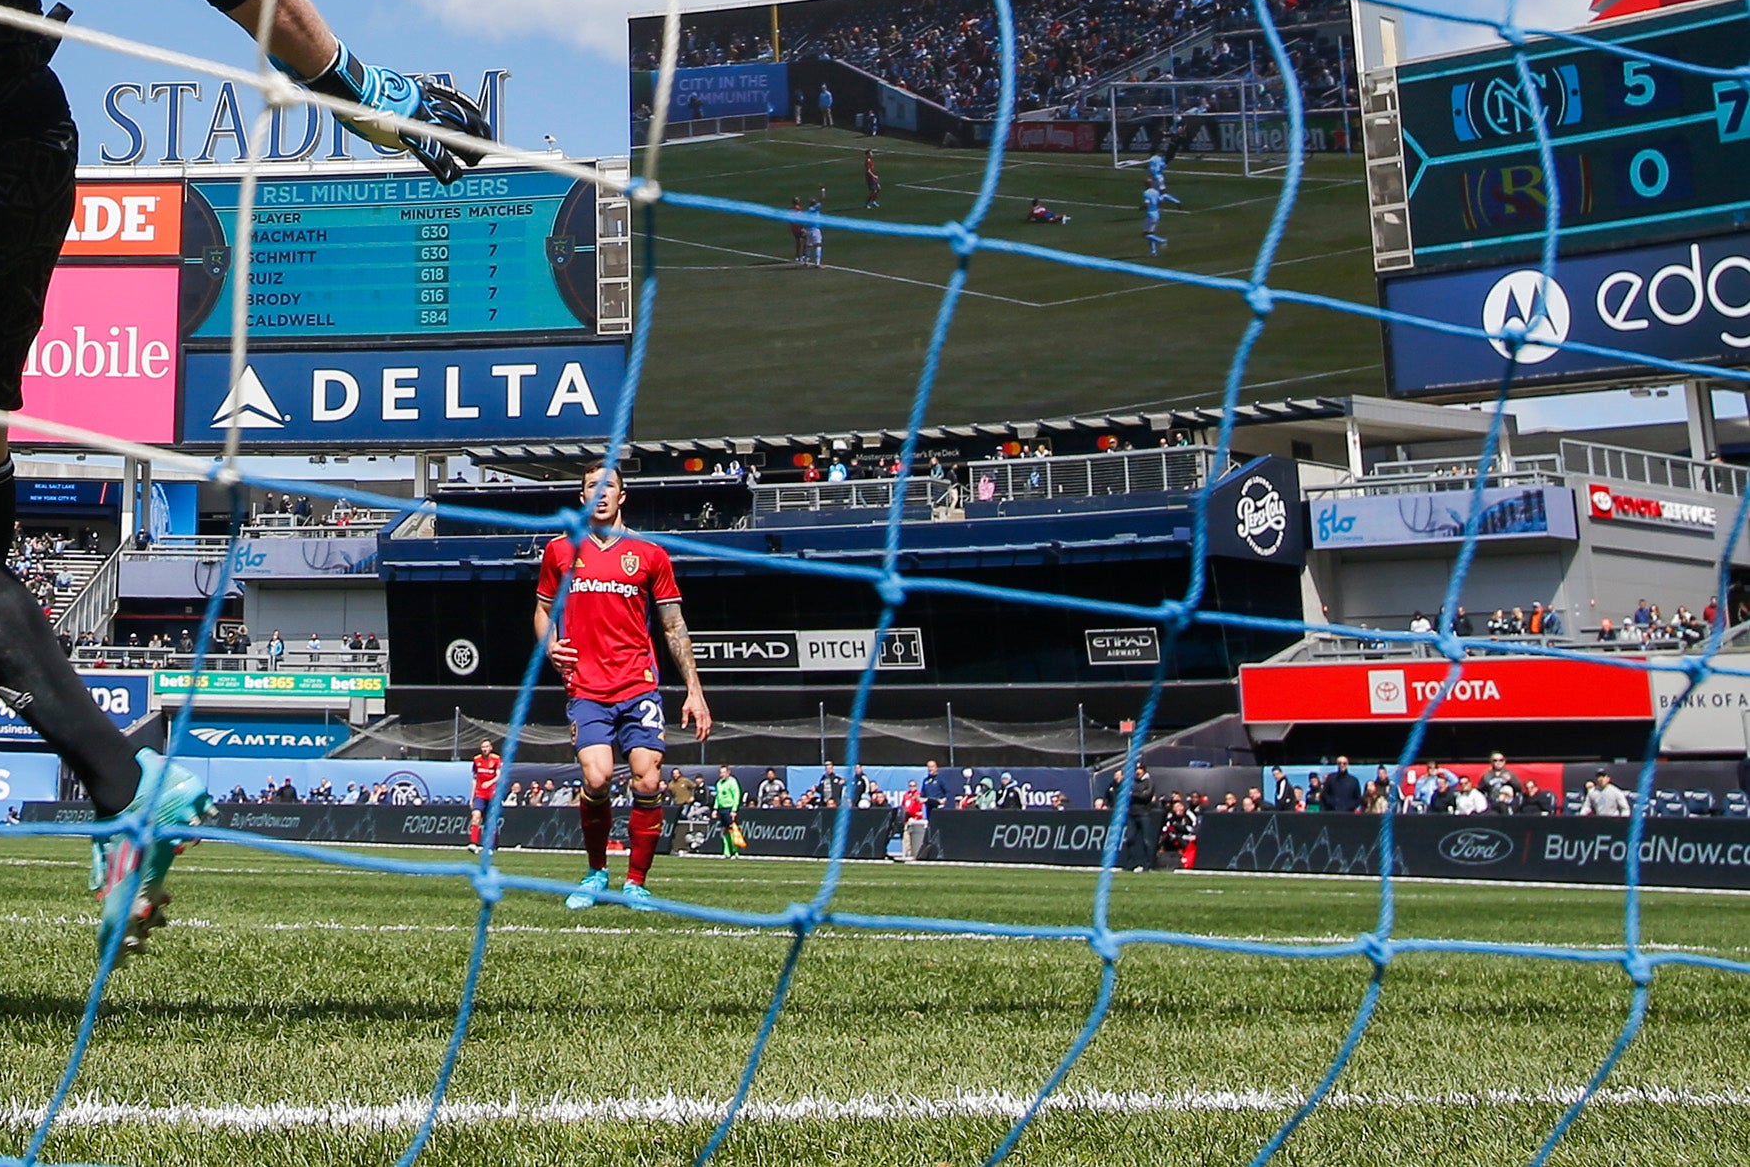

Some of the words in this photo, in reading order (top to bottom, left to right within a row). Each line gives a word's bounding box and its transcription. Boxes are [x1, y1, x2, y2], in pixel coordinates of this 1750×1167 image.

[678, 78, 715, 91] CITY
[719, 76, 735, 89] IN
[739, 74, 768, 88] THE
[1622, 60, 1657, 107] 5
[1220, 123, 1326, 152] Heineen
[262, 185, 305, 204] RSL
[311, 182, 398, 203] MINUTE
[404, 178, 510, 200] LEADERS
[251, 212, 302, 224] PLAYER
[400, 207, 462, 220] MINUTES
[468, 204, 534, 218] MATCHES
[421, 225, 449, 239] 630
[488, 223, 498, 236] 7
[421, 246, 449, 260] 630
[488, 244, 498, 257] 7
[420, 268, 445, 281] 618
[488, 265, 498, 278] 7
[420, 289, 445, 302] 616
[488, 287, 498, 299] 7
[420, 310, 448, 324] 584
[488, 308, 498, 321] 7
[312, 361, 601, 423] DELTA
[1317, 503, 1357, 542] flo
[690, 641, 791, 660] ETIHAD
[809, 640, 867, 659] PITCH
[1092, 635, 1153, 648] ETIHAD
[1106, 648, 1142, 657] AIRWAYS
[244, 675, 296, 689] bet365
[330, 676, 383, 691] bet365
[1412, 680, 1500, 701] TOYOTA
[1660, 694, 1707, 709] BANK
[1712, 695, 1733, 708] OF
[227, 734, 329, 746] AMTRAK
[230, 811, 301, 829] BuyFordNow.com
[402, 814, 441, 835] FORD
[990, 823, 1053, 849] FORD
[1450, 831, 1500, 859] Ford
